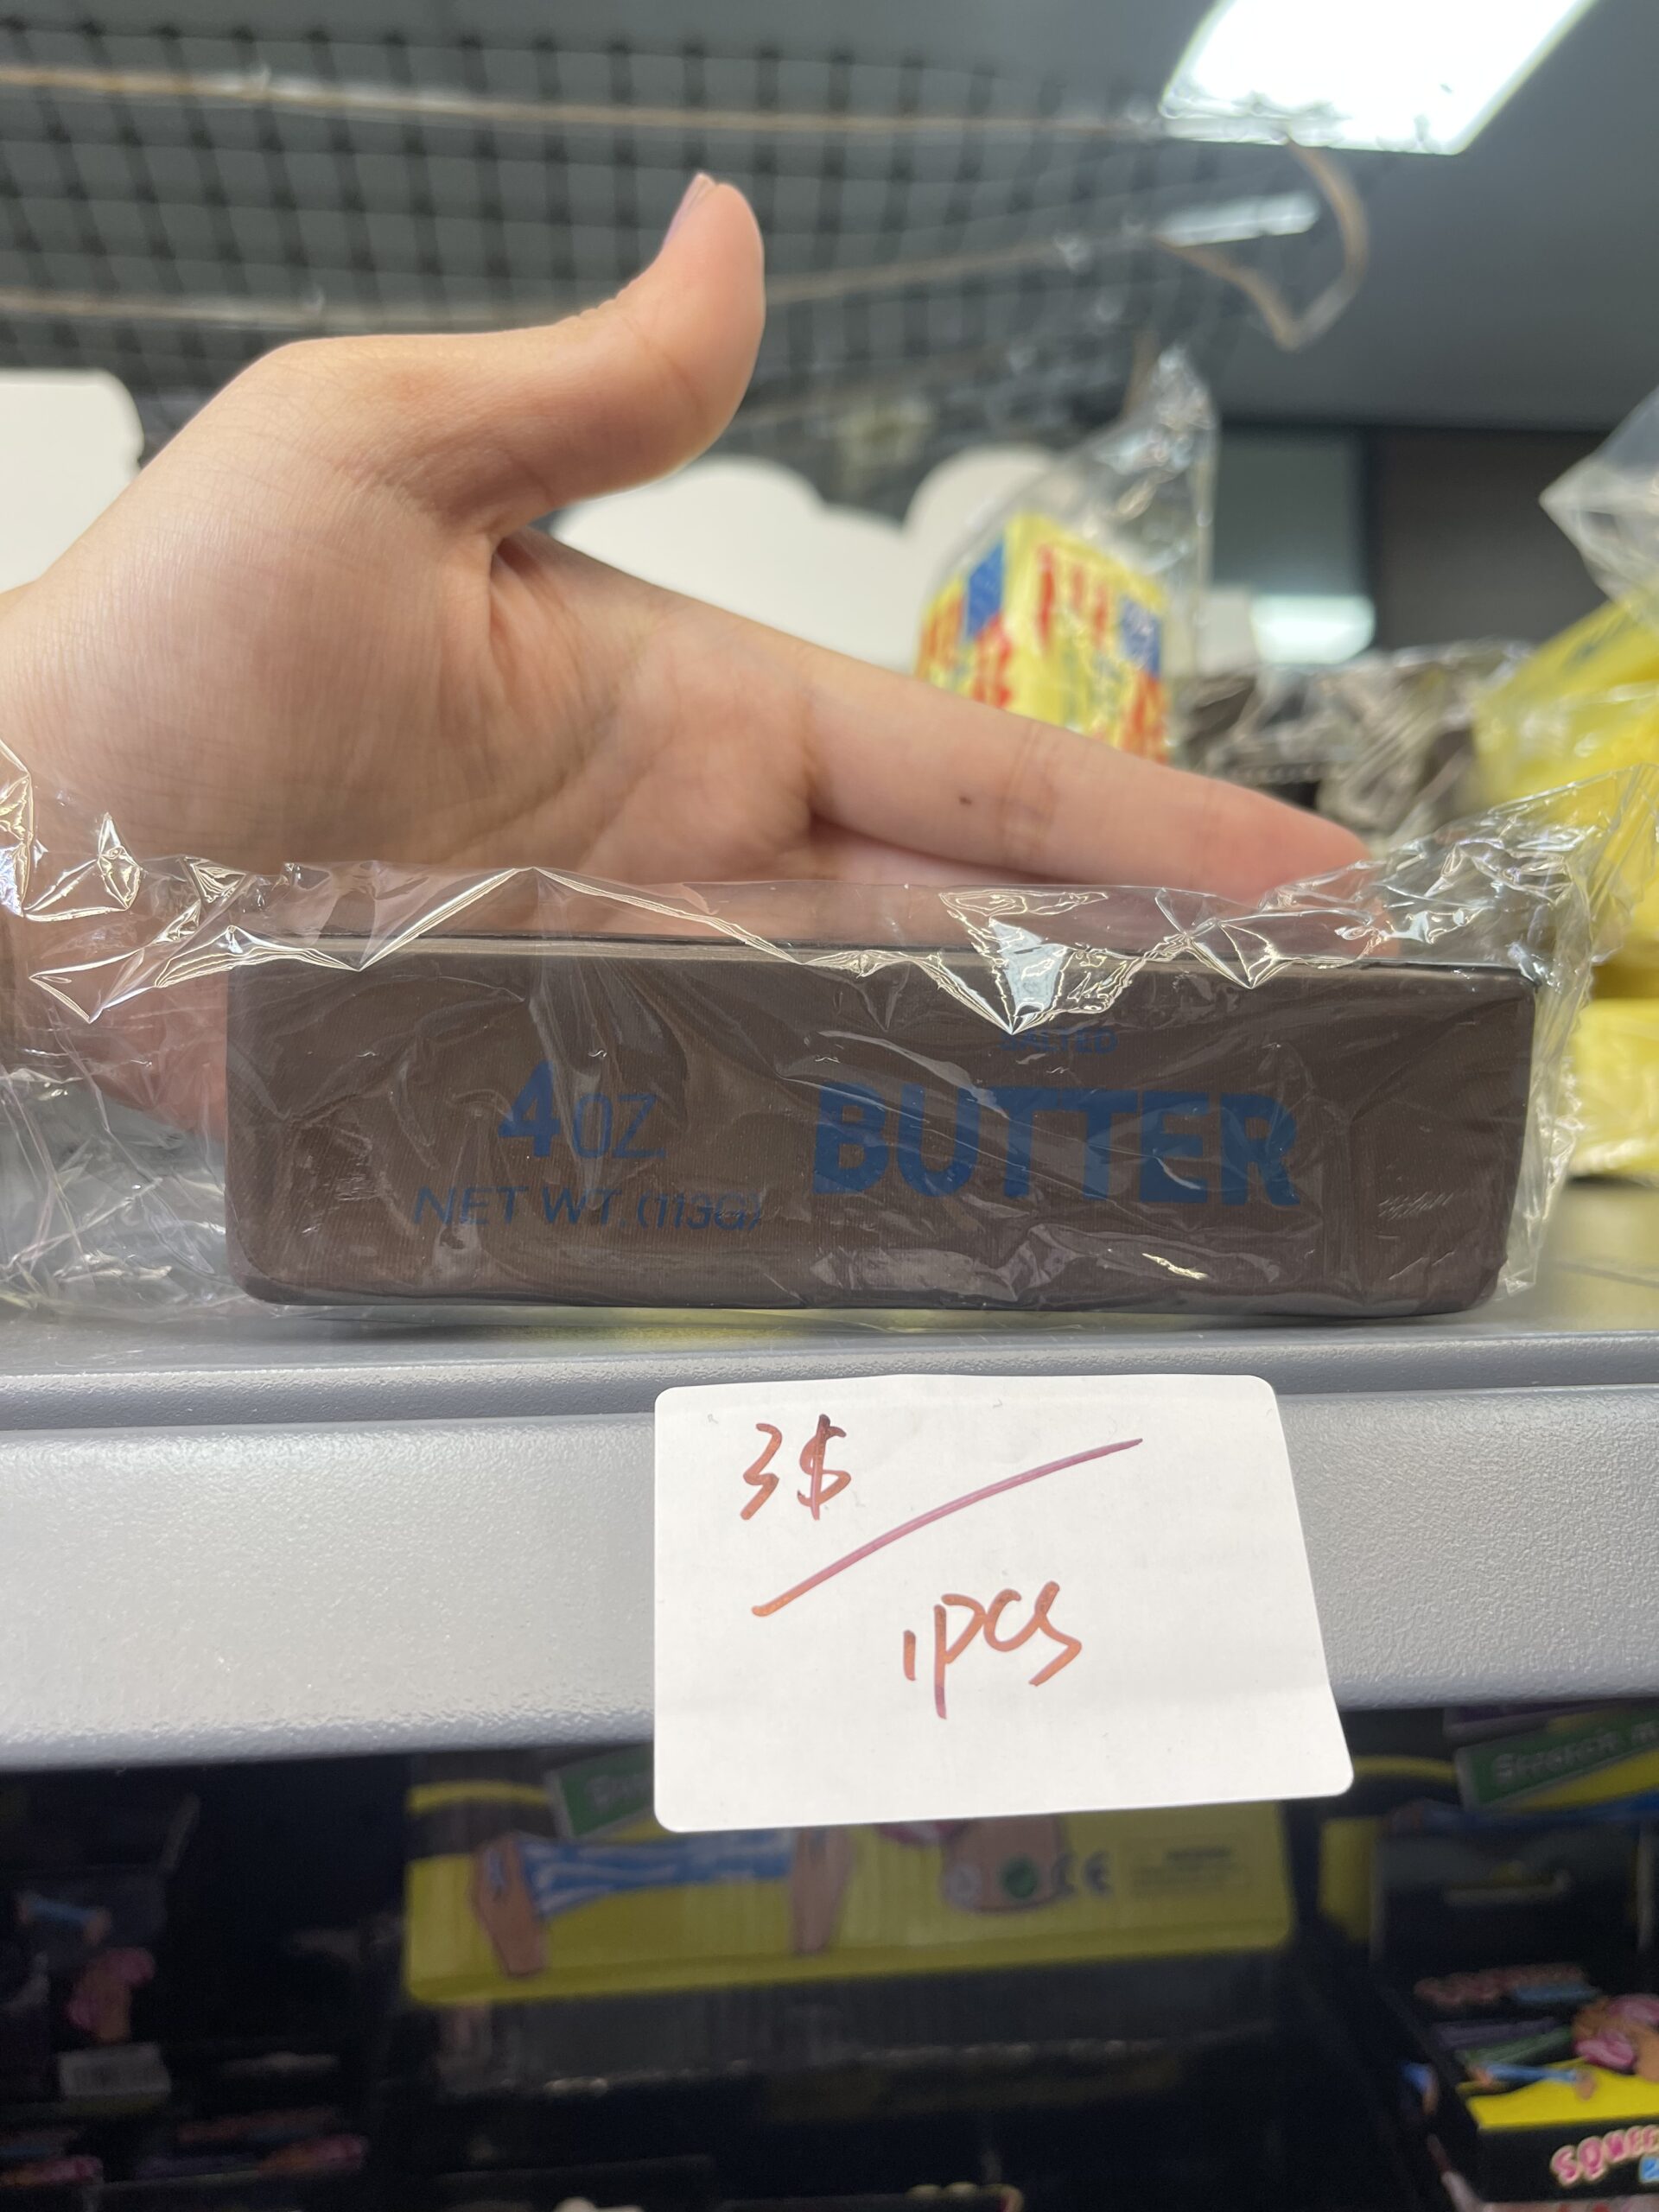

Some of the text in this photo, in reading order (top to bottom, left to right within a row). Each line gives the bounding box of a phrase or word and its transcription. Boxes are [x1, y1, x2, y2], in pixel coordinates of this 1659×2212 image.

[812, 1081, 1300, 1205] BUTTER
[413, 1185, 530, 1226] NET
[740, 1414, 853, 1521] 3$
